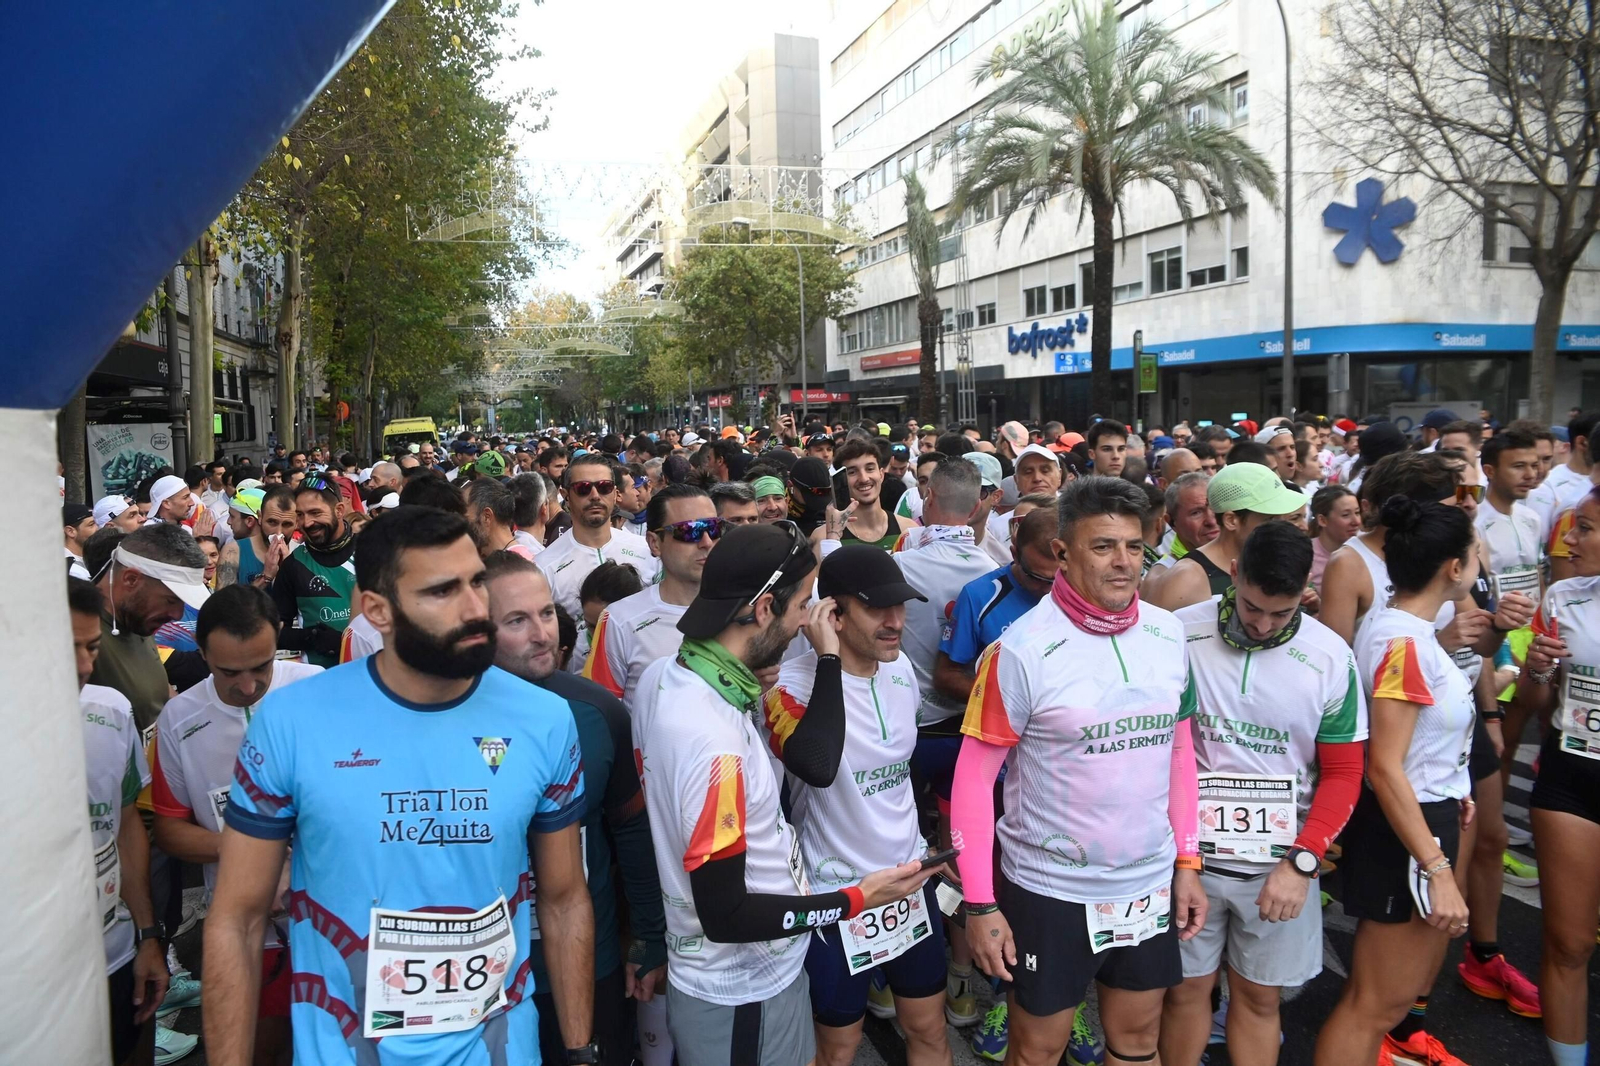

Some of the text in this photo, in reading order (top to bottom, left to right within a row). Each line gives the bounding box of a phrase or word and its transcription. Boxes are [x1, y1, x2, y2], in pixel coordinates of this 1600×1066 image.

[1008, 317, 1075, 359] bofrost
[1265, 338, 1310, 353] Sabell
[1441, 333, 1487, 346] Sabadell
[1164, 349, 1195, 362] Sabadell
[621, 548, 634, 557] SIG
[1143, 623, 1161, 637] SIG
[1287, 647, 1308, 663] SIG
[1570, 664, 1595, 676] XII
[87, 713, 106, 725] SIG
[1079, 722, 1111, 741] XII
[1195, 713, 1290, 742] XII SUBIDA
[1083, 745, 1095, 754] A
[1099, 740, 1126, 754] LAS
[1200, 731, 1288, 755] A LAS ERMITAS
[334, 758, 382, 769] TEAMERGY
[1208, 779, 1234, 788] SUBIDA
[1241, 781, 1256, 789] LAS
[1210, 789, 1218, 797] LA
[380, 789, 489, 814] TriaTlon
[1214, 805, 1272, 833] 131
[379, 818, 495, 847] MeZquita
[380, 907, 504, 932] XII SUBIDA A LAS ERMITAS
[862, 898, 910, 940] 369
[379, 919, 508, 946] POR LA DONACIÓN DE ORGANOS
[401, 954, 489, 995] 518
